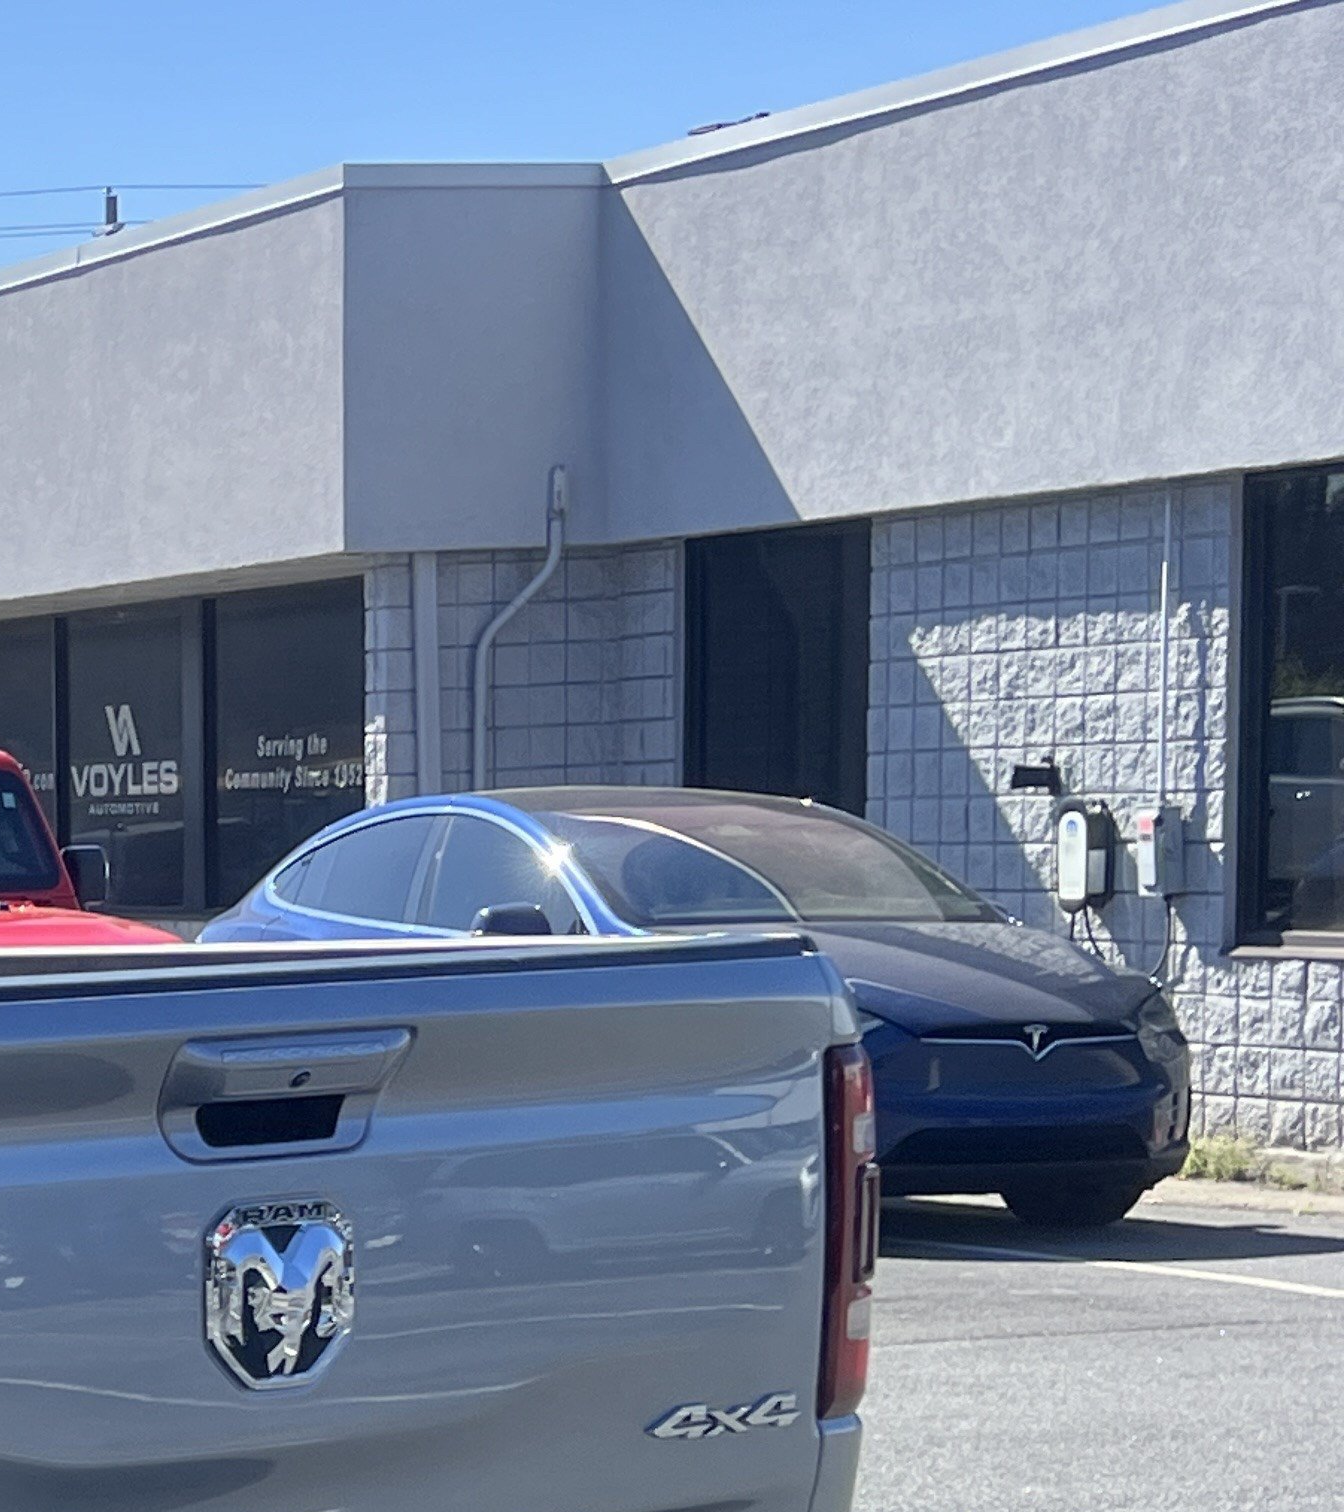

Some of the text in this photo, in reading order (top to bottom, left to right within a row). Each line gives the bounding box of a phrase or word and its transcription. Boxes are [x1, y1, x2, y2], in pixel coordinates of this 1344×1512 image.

[256, 732, 327, 761] Serving the
[70, 760, 179, 797] VOYLES
[224, 768, 293, 794] Community
[294, 764, 330, 788] Since
[88, 801, 160, 816] AUTOMOTIVE
[239, 1202, 325, 1225] RAM
[646, 1391, 802, 1439] 4x4
